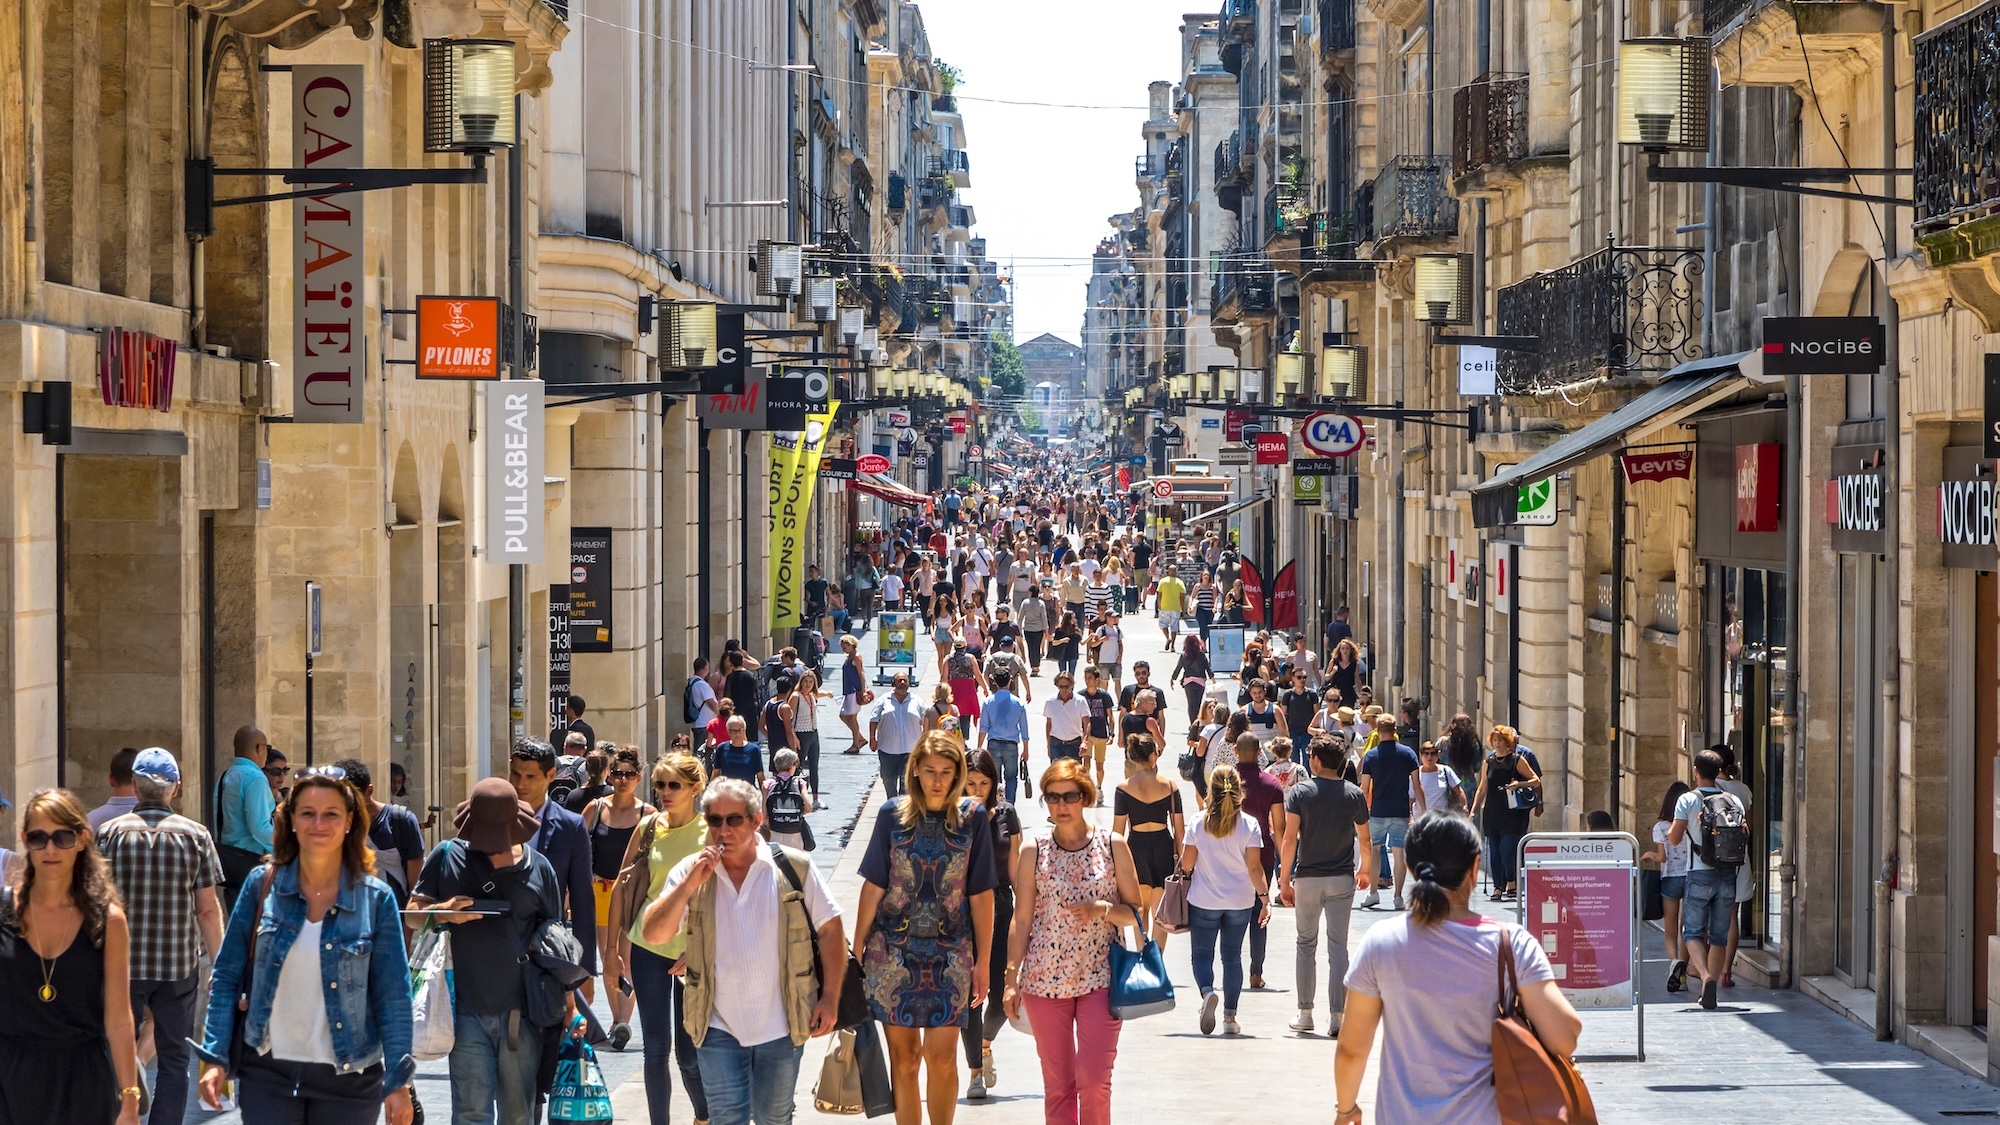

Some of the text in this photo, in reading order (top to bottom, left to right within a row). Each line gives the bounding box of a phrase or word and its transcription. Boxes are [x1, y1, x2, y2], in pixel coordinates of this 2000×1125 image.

[425, 346, 492, 366] PYLONES
[768, 401, 802, 409] PHORA
[952, 421, 966, 429] SFR
[1312, 420, 1355, 444] C&A
[1258, 442, 1287, 452] HEMA
[504, 393, 528, 552] PULL&BEAR
[860, 463, 886, 472] Dorée
[776, 536, 794, 619] VIVONS
[576, 600, 597, 608] SANTÉ
